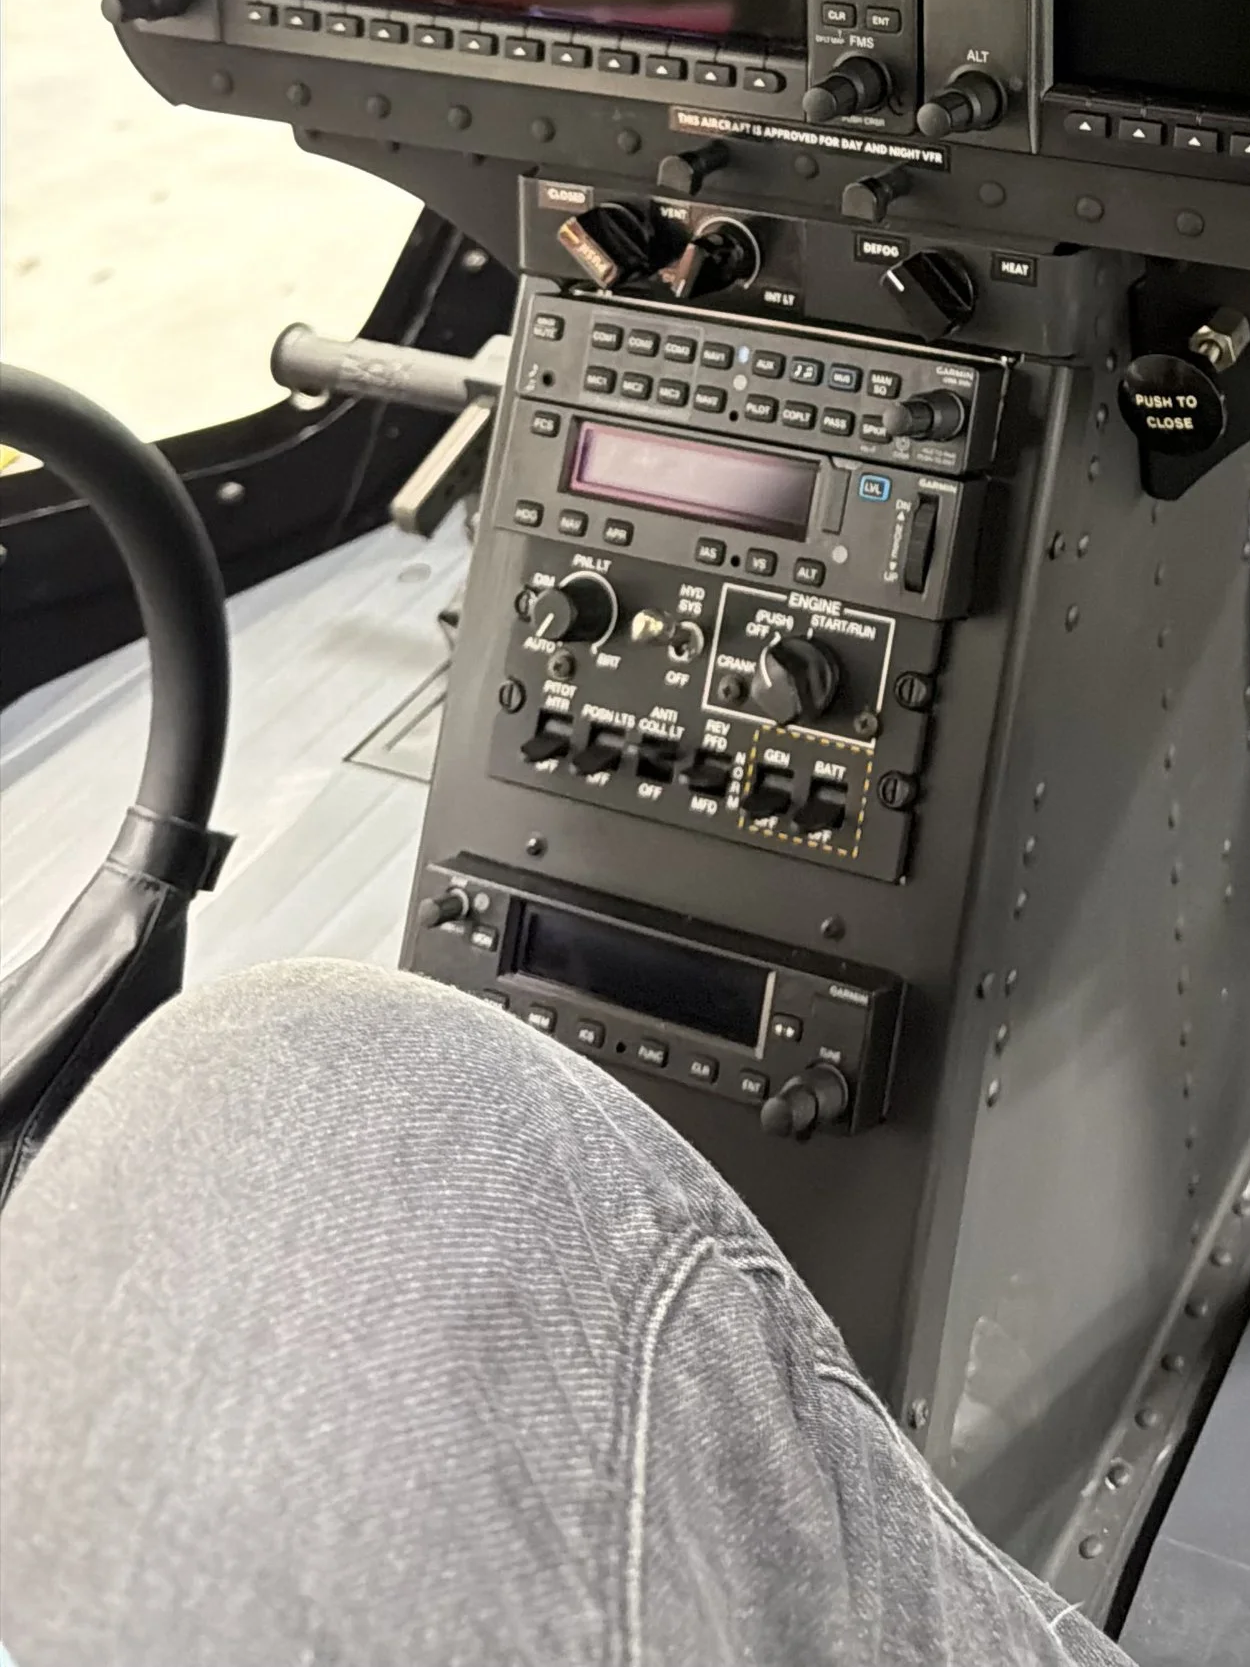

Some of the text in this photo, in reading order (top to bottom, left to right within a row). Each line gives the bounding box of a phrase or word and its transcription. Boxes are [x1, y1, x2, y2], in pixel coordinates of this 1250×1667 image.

[828, 10, 845, 20] CLR
[872, 16, 890, 26] ENT
[850, 36, 873, 49] FMS
[967, 49, 989, 62] ALT
[678, 113, 942, 164] THIS AIRCRAFT IS APPROVED FOR DAY AND NIGHT VFR
[660, 207, 687, 219] VENT
[864, 242, 899, 257] DEFOG
[1001, 262, 1029, 276] HEAT
[593, 332, 616, 343] COM1
[756, 360, 774, 369] AUX
[871, 375, 892, 386] MAN
[936, 366, 973, 380] GARMIN
[746, 403, 770, 414] PILOT
[1135, 394, 1197, 408] PUSH TO
[824, 417, 846, 429] PASS
[1147, 416, 1193, 430] CLOSE
[864, 483, 881, 494] LVL
[919, 479, 957, 493] GARMIN
[700, 547, 717, 558] IAS
[572, 554, 612, 573] PNL LT
[797, 568, 818, 578] ALT
[678, 599, 702, 614] SYS
[788, 592, 842, 616] ENGINE
[756, 609, 794, 630] (PUSH)
[746, 622, 770, 638] OFF
[811, 615, 876, 641] START/RUN
[524, 637, 555, 653] AUTO
[717, 654, 757, 673] CRANK
[665, 670, 690, 686] OFF
[614, 712, 636, 729] LTS
[650, 706, 678, 724] ANTI
[638, 717, 685, 740] COLL LT
[705, 719, 730, 736] REV
[702, 733, 727, 752] PFD
[764, 749, 790, 767] GEN
[814, 760, 846, 780] BATT
[726, 751, 746, 810] NORM
[637, 783, 662, 800] OFF
[690, 795, 717, 815] MFD
